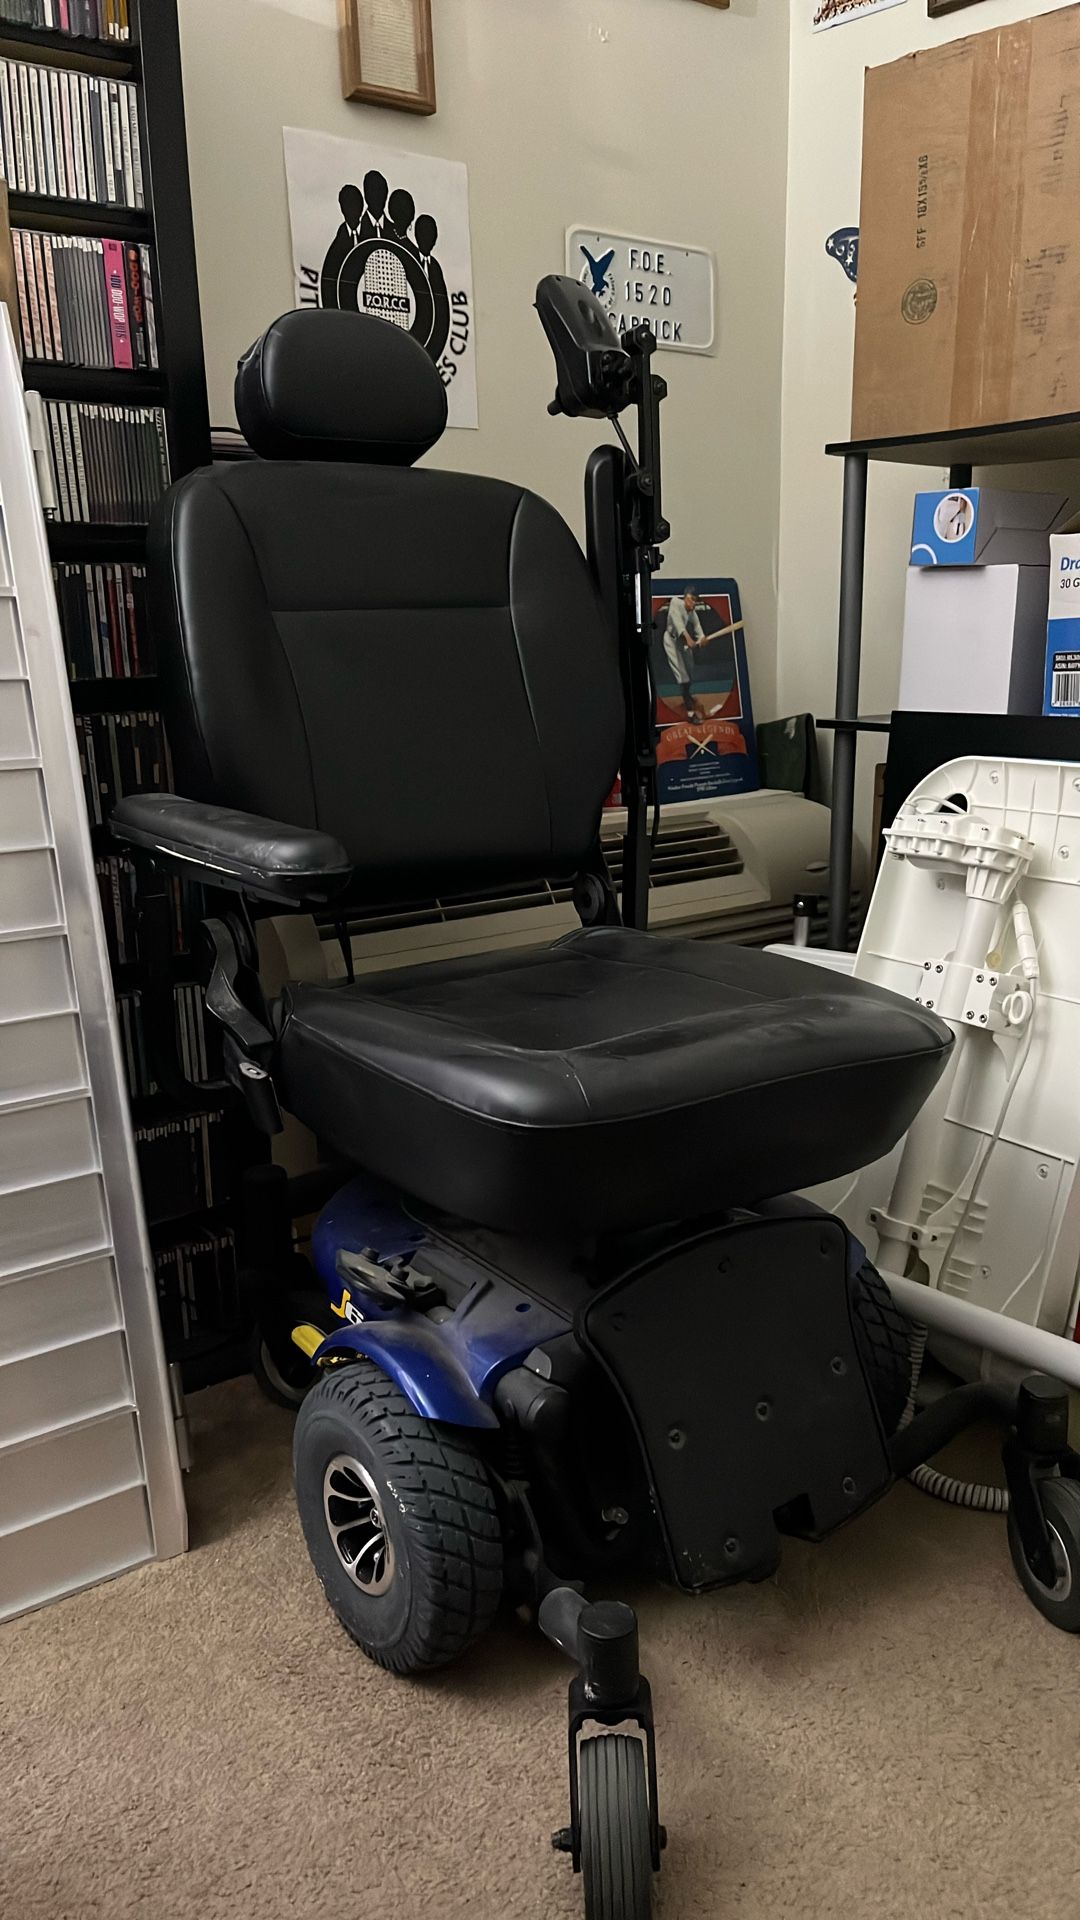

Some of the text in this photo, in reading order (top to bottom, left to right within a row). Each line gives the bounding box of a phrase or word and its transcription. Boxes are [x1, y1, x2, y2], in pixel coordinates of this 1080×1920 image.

[629, 248, 672, 275] F.O.E.
[366, 293, 408, 312] P.O.R.C.C.
[625, 280, 671, 306] 1520
[450, 291, 469, 355] CLUB
[1060, 578, 1071, 589] 30
